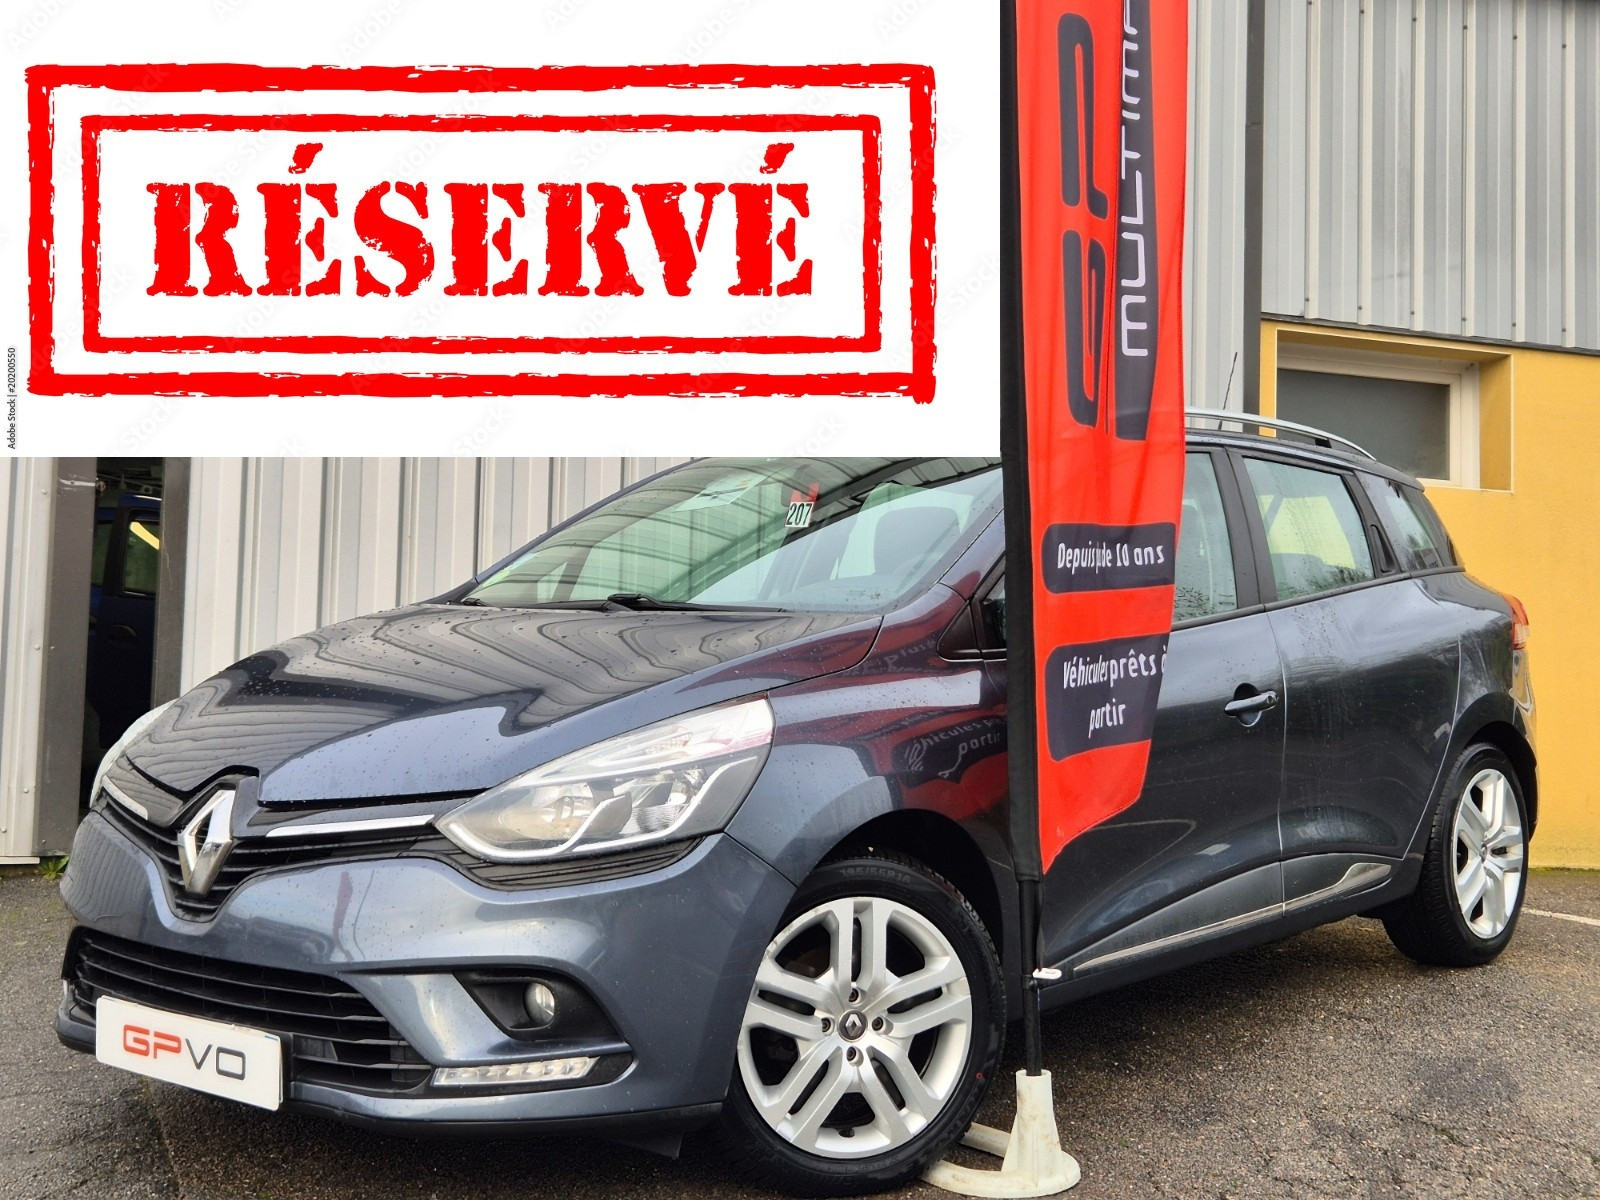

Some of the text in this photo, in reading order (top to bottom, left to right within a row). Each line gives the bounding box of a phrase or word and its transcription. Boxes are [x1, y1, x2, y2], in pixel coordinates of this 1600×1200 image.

[786, 502, 813, 526] 207
[1057, 540, 1095, 575] Depuis
[1116, 543, 1130, 567] 10
[1134, 544, 1165, 566] ans
[1063, 654, 1109, 690] Véhicules
[1109, 648, 1157, 688] prêts
[1088, 698, 1126, 739] partir
[123, 1024, 246, 1081] GPVO
